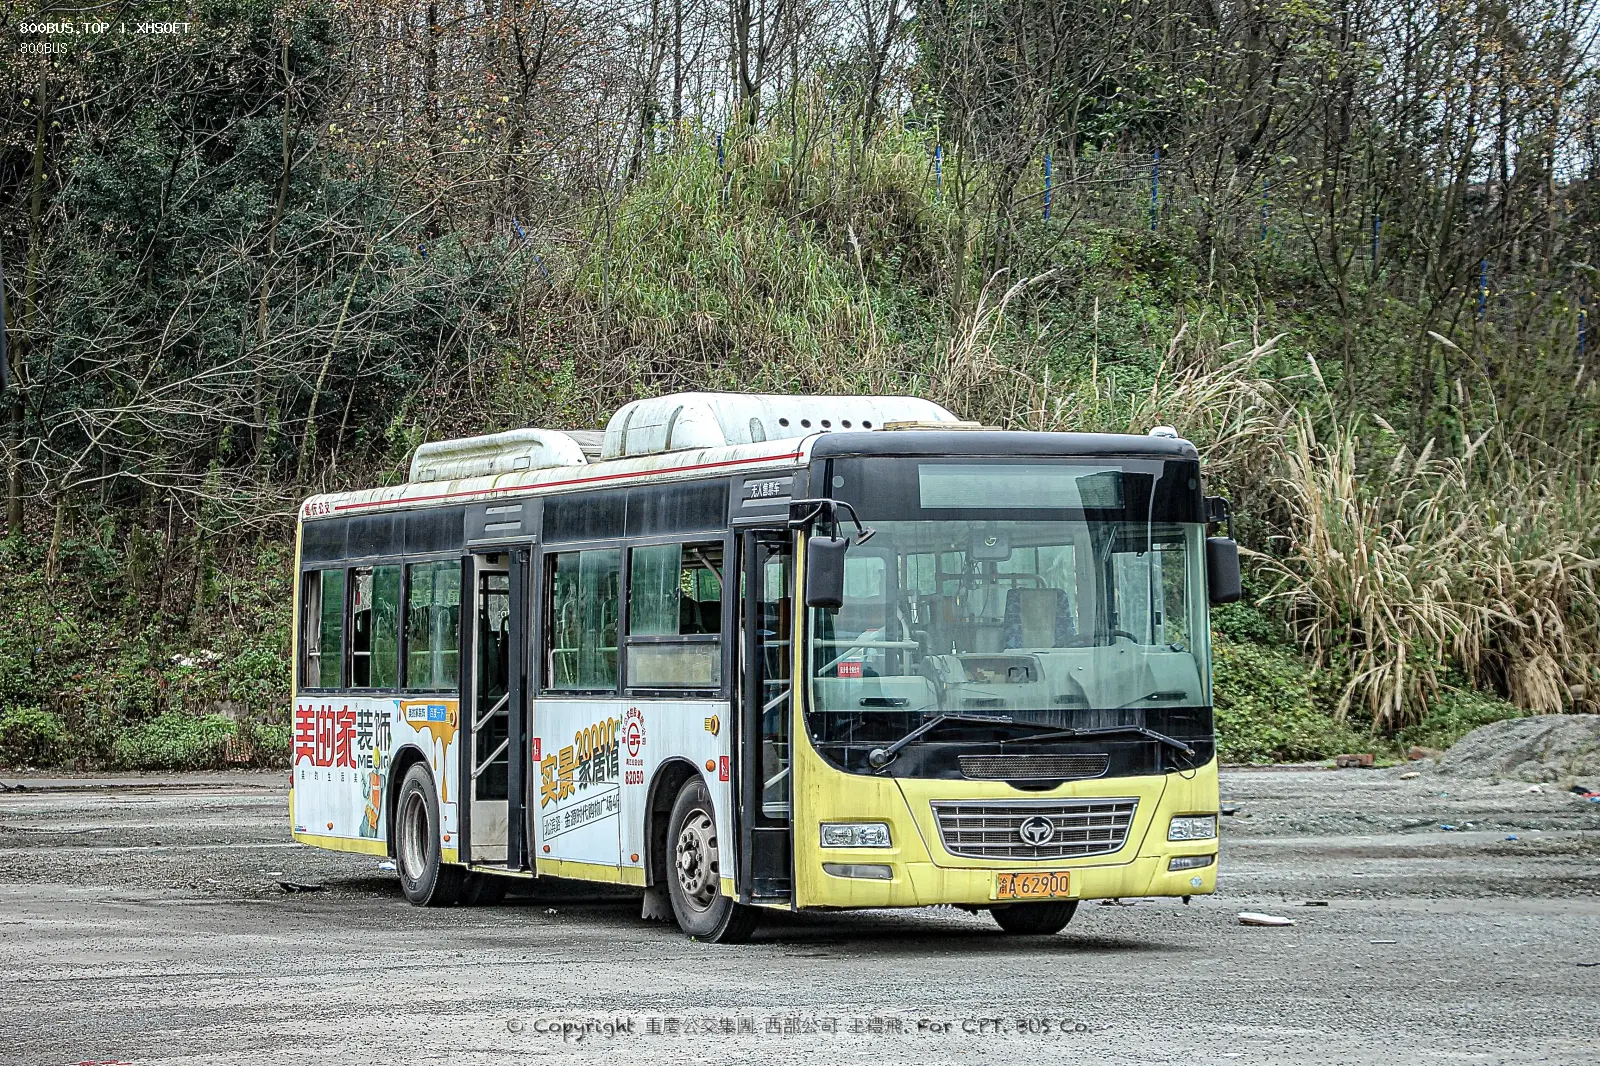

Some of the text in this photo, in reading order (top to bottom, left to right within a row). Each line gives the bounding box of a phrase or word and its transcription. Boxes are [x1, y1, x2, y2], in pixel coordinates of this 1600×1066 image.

[750, 482, 780, 498] 无人售票车
[625, 770, 645, 784] 82050
